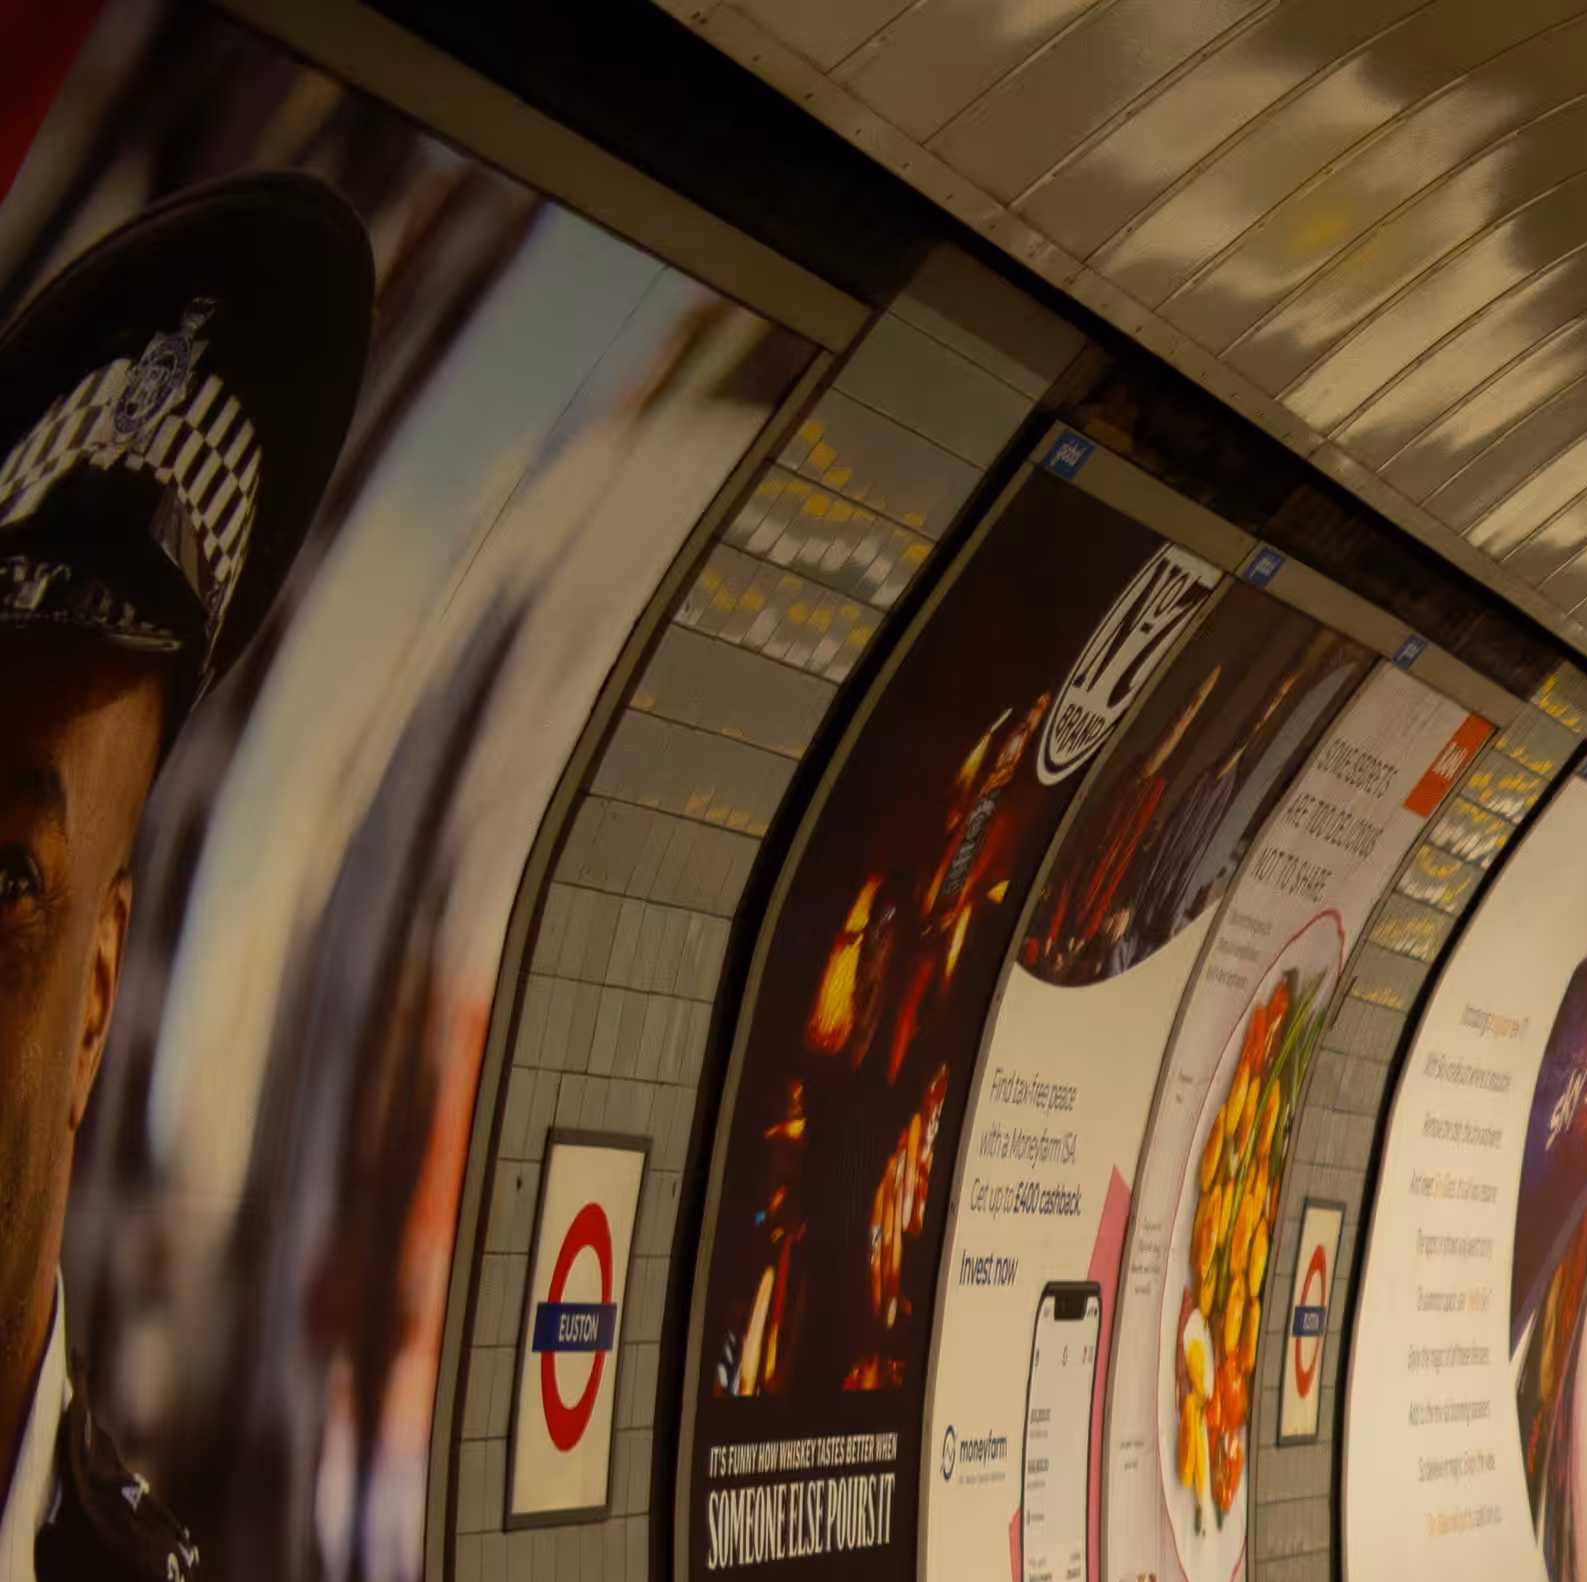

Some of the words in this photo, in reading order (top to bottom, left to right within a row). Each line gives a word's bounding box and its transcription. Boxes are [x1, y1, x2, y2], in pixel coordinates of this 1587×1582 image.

[1055, 702, 1106, 756] BRAND
[990, 1067, 1015, 1105] Find
[979, 1121, 1001, 1158] with
[1011, 1127, 1062, 1169] Moneyfarm
[970, 1177, 989, 1213] Get
[989, 1186, 1003, 1219] up
[1003, 1185, 1013, 1214] to
[1013, 1179, 1040, 1215] £400
[959, 1249, 993, 1286] Invest
[993, 1257, 1019, 1286] now
[558, 1312, 600, 1343] EUSTON
[709, 1446, 726, 1478] IT'S
[728, 1442, 757, 1476] FUNNY
[758, 1440, 779, 1473] HOW
[779, 1438, 817, 1471] WHISKEY
[817, 1435, 845, 1467] TASTES
[846, 1434, 875, 1465] BETTER
[875, 1432, 898, 1461] WHEN
[959, 1429, 1008, 1465] moneyfarm
[707, 1482, 787, 1571] SOMEONE
[788, 1479, 825, 1557] ELSE
[826, 1473, 877, 1553] POURS
[877, 1472, 896, 1545] IT
